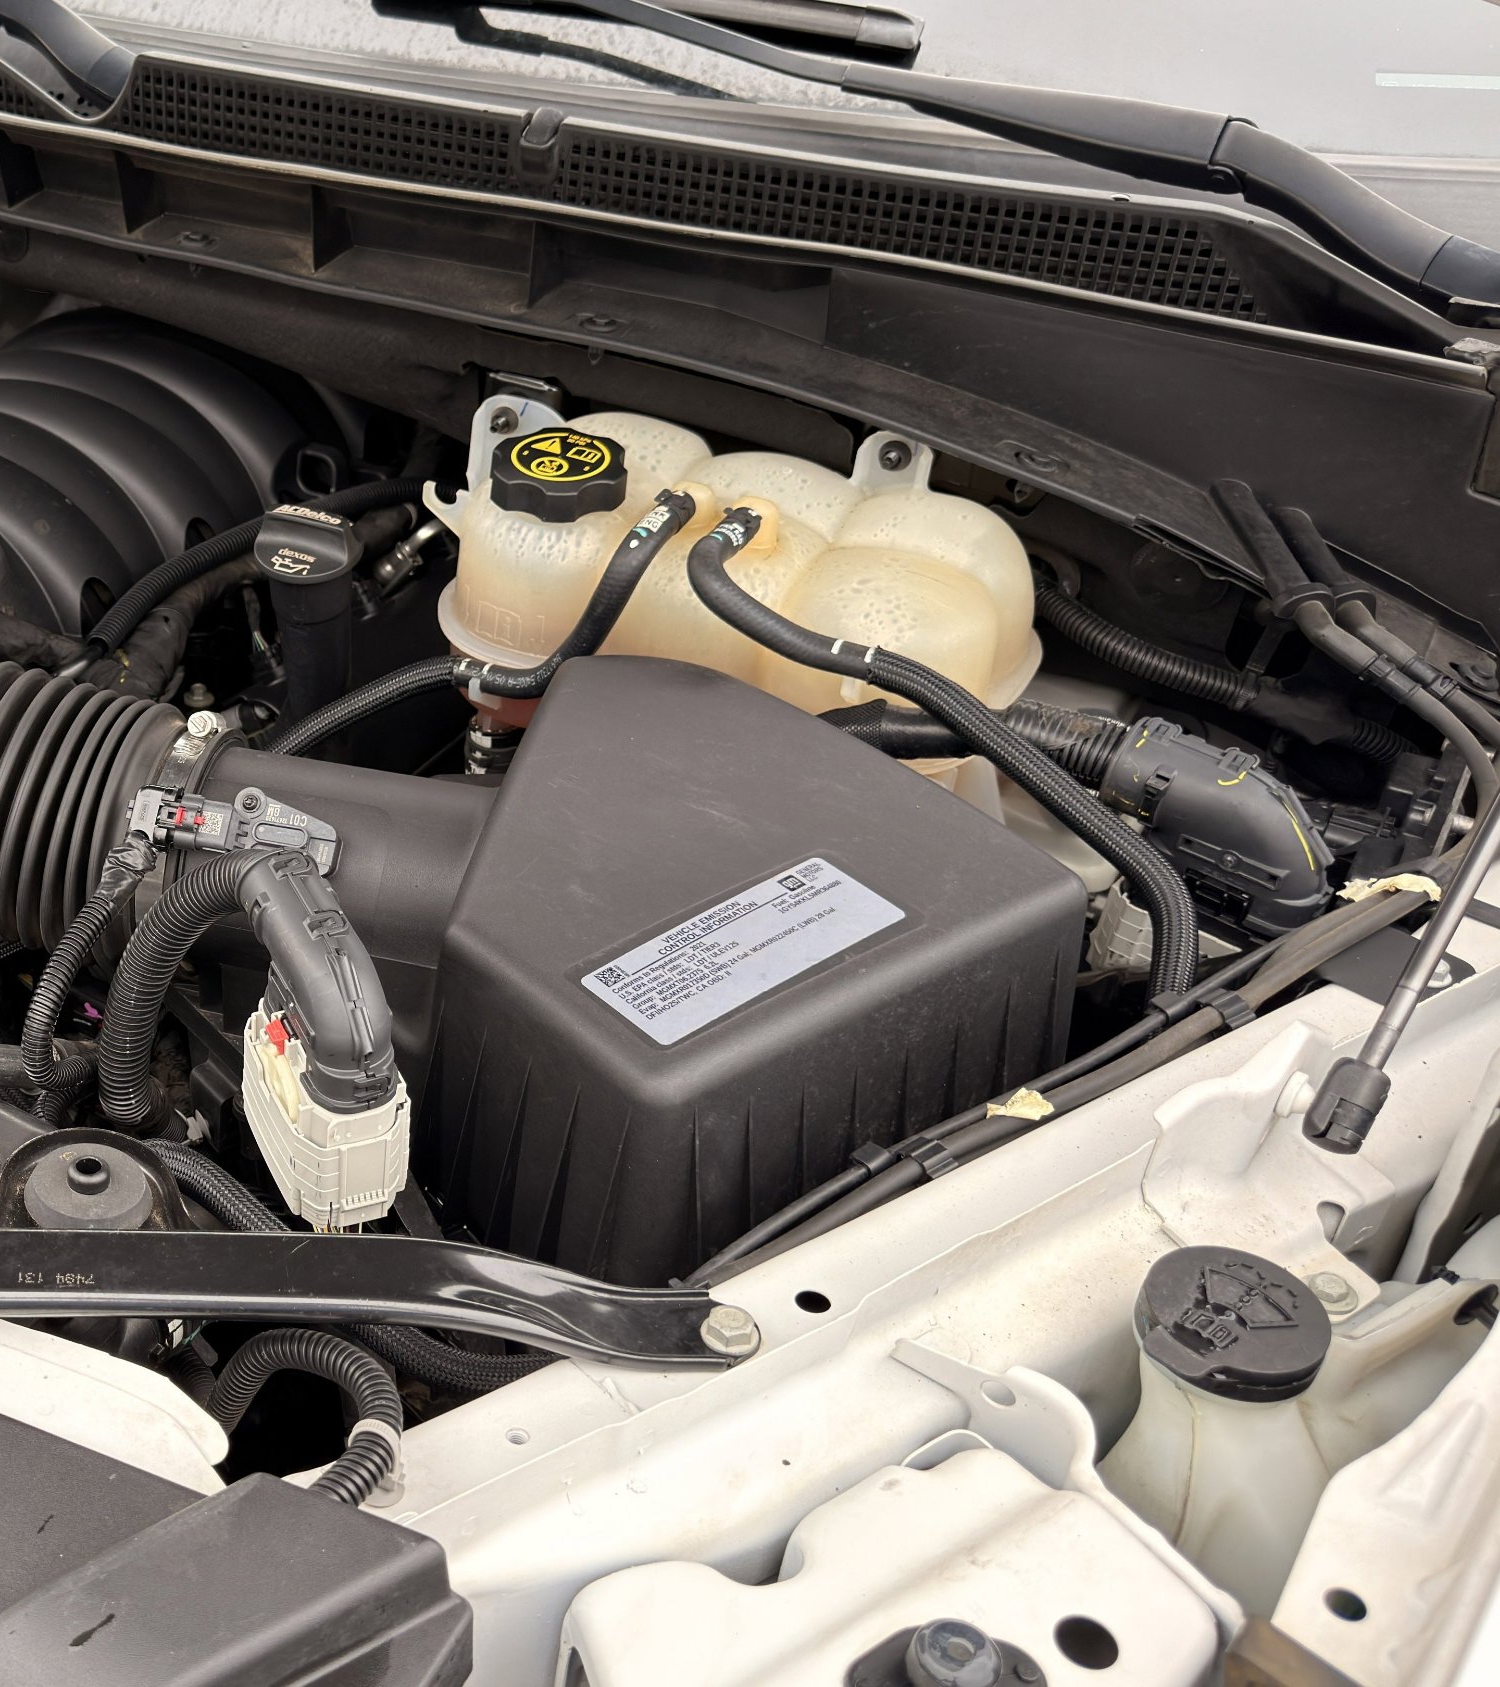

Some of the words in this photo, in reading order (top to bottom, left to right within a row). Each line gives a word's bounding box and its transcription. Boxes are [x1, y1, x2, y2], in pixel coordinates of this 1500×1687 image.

[272, 504, 341, 525] ACDelco
[277, 548, 317, 563] dexos
[795, 863, 820, 875] GENERAL
[801, 865, 823, 878] MOTORS
[771, 899, 789, 909] Fuel:
[788, 885, 816, 900] Gasoline
[658, 932, 701, 955] CONTROL
[699, 902, 758, 933] INFORMATION
[662, 922, 700, 943] VEHICLE
[699, 902, 741, 924] EMISSION
[612, 976, 644, 994] Conforms
[649, 951, 689, 973] Regulations:
[689, 941, 706, 951] 2021
[638, 1003, 659, 1015] Evap:
[709, 962, 731, 976] (SWB)
[823, 907, 836, 915] Gal
[618, 990, 634, 999] U.S.
[632, 982, 647, 992] EPA
[647, 973, 665, 984] class
[683, 953, 699, 963] LDT
[625, 986, 657, 1004] California
[656, 977, 674, 988] class
[693, 957, 708, 967] LDT
[696, 984, 709, 992] CA
[632, 996, 656, 1009] Group:
